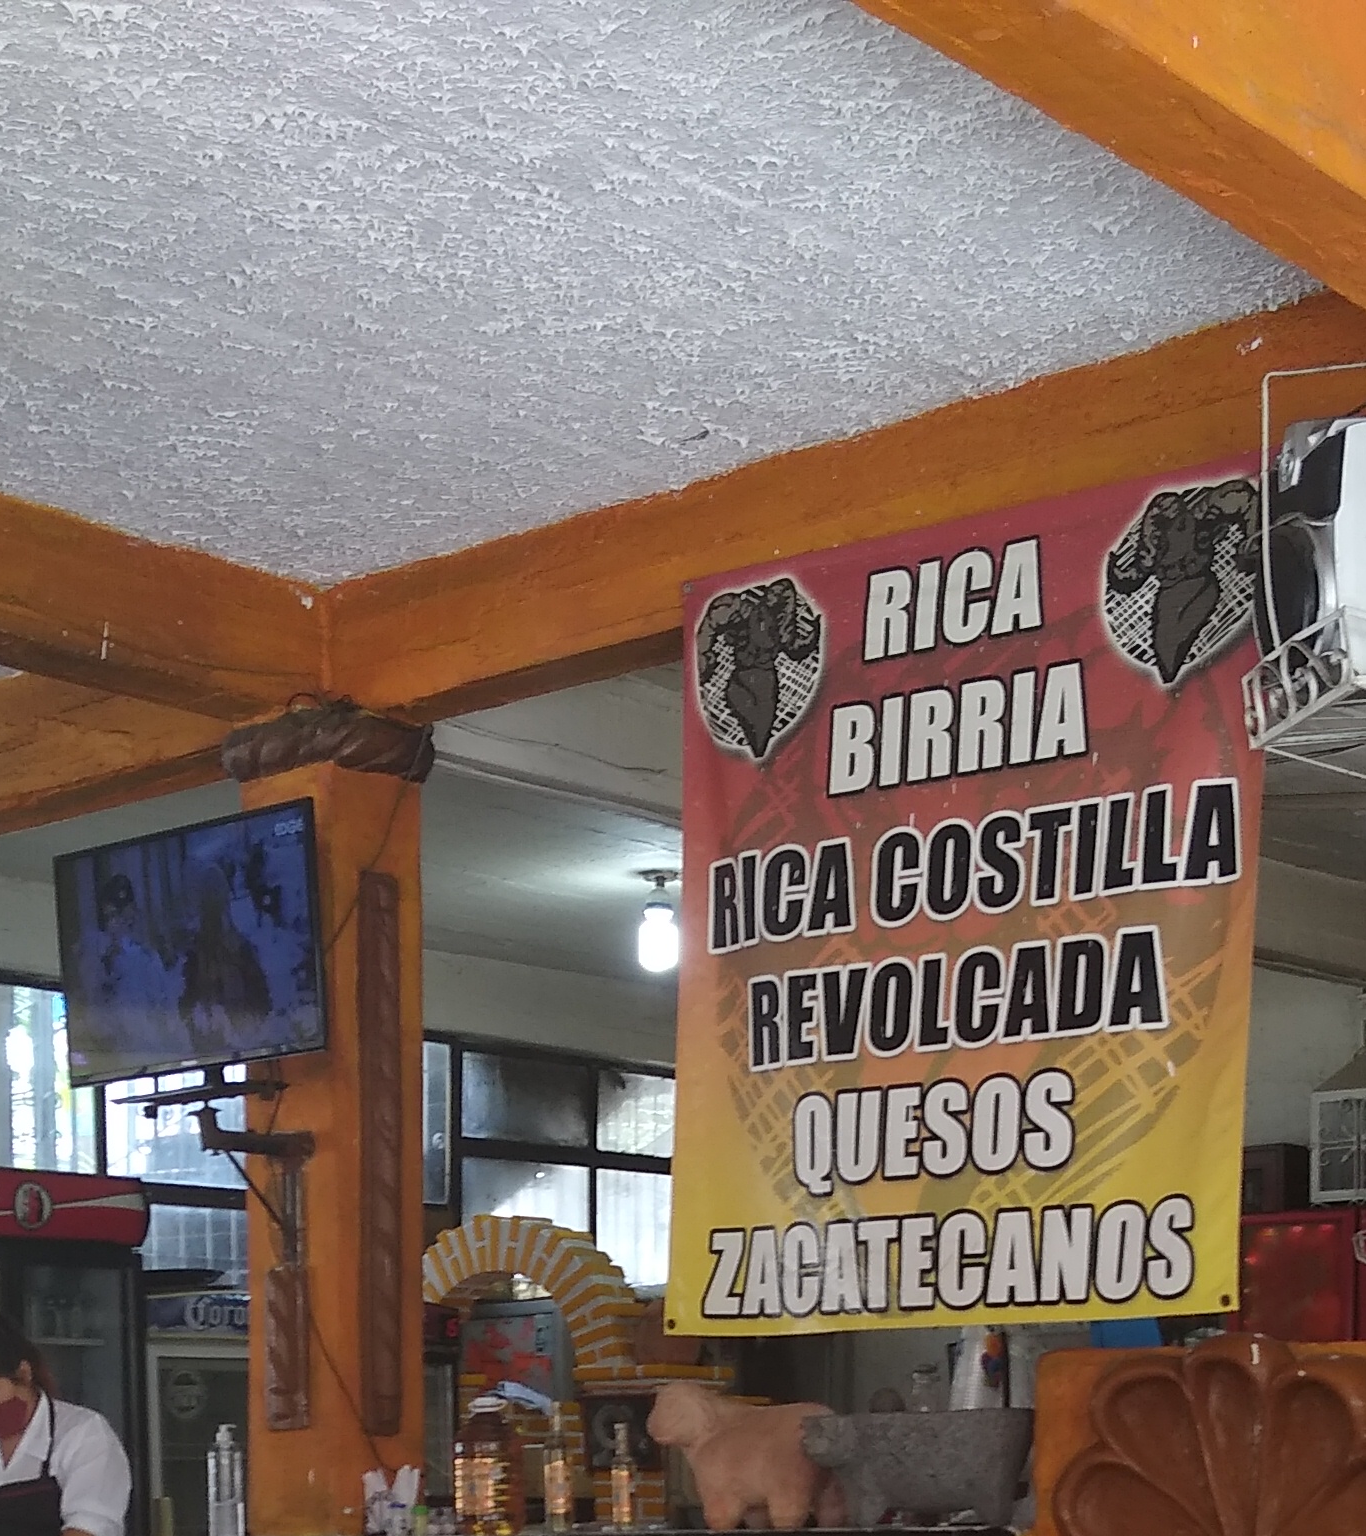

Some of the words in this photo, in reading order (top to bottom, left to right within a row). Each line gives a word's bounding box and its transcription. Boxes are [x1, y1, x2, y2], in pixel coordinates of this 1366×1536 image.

[864, 538, 1043, 662] RICA
[827, 662, 1087, 797] BIRRIA
[708, 836, 854, 955] RICA
[871, 776, 1240, 928] COSTILLA
[747, 926, 1167, 1072] REVOLCADA
[792, 1070, 1076, 1195] QUESOS
[185, 1298, 247, 1331] Coro
[702, 1195, 1195, 1319] ZACATECANOS
